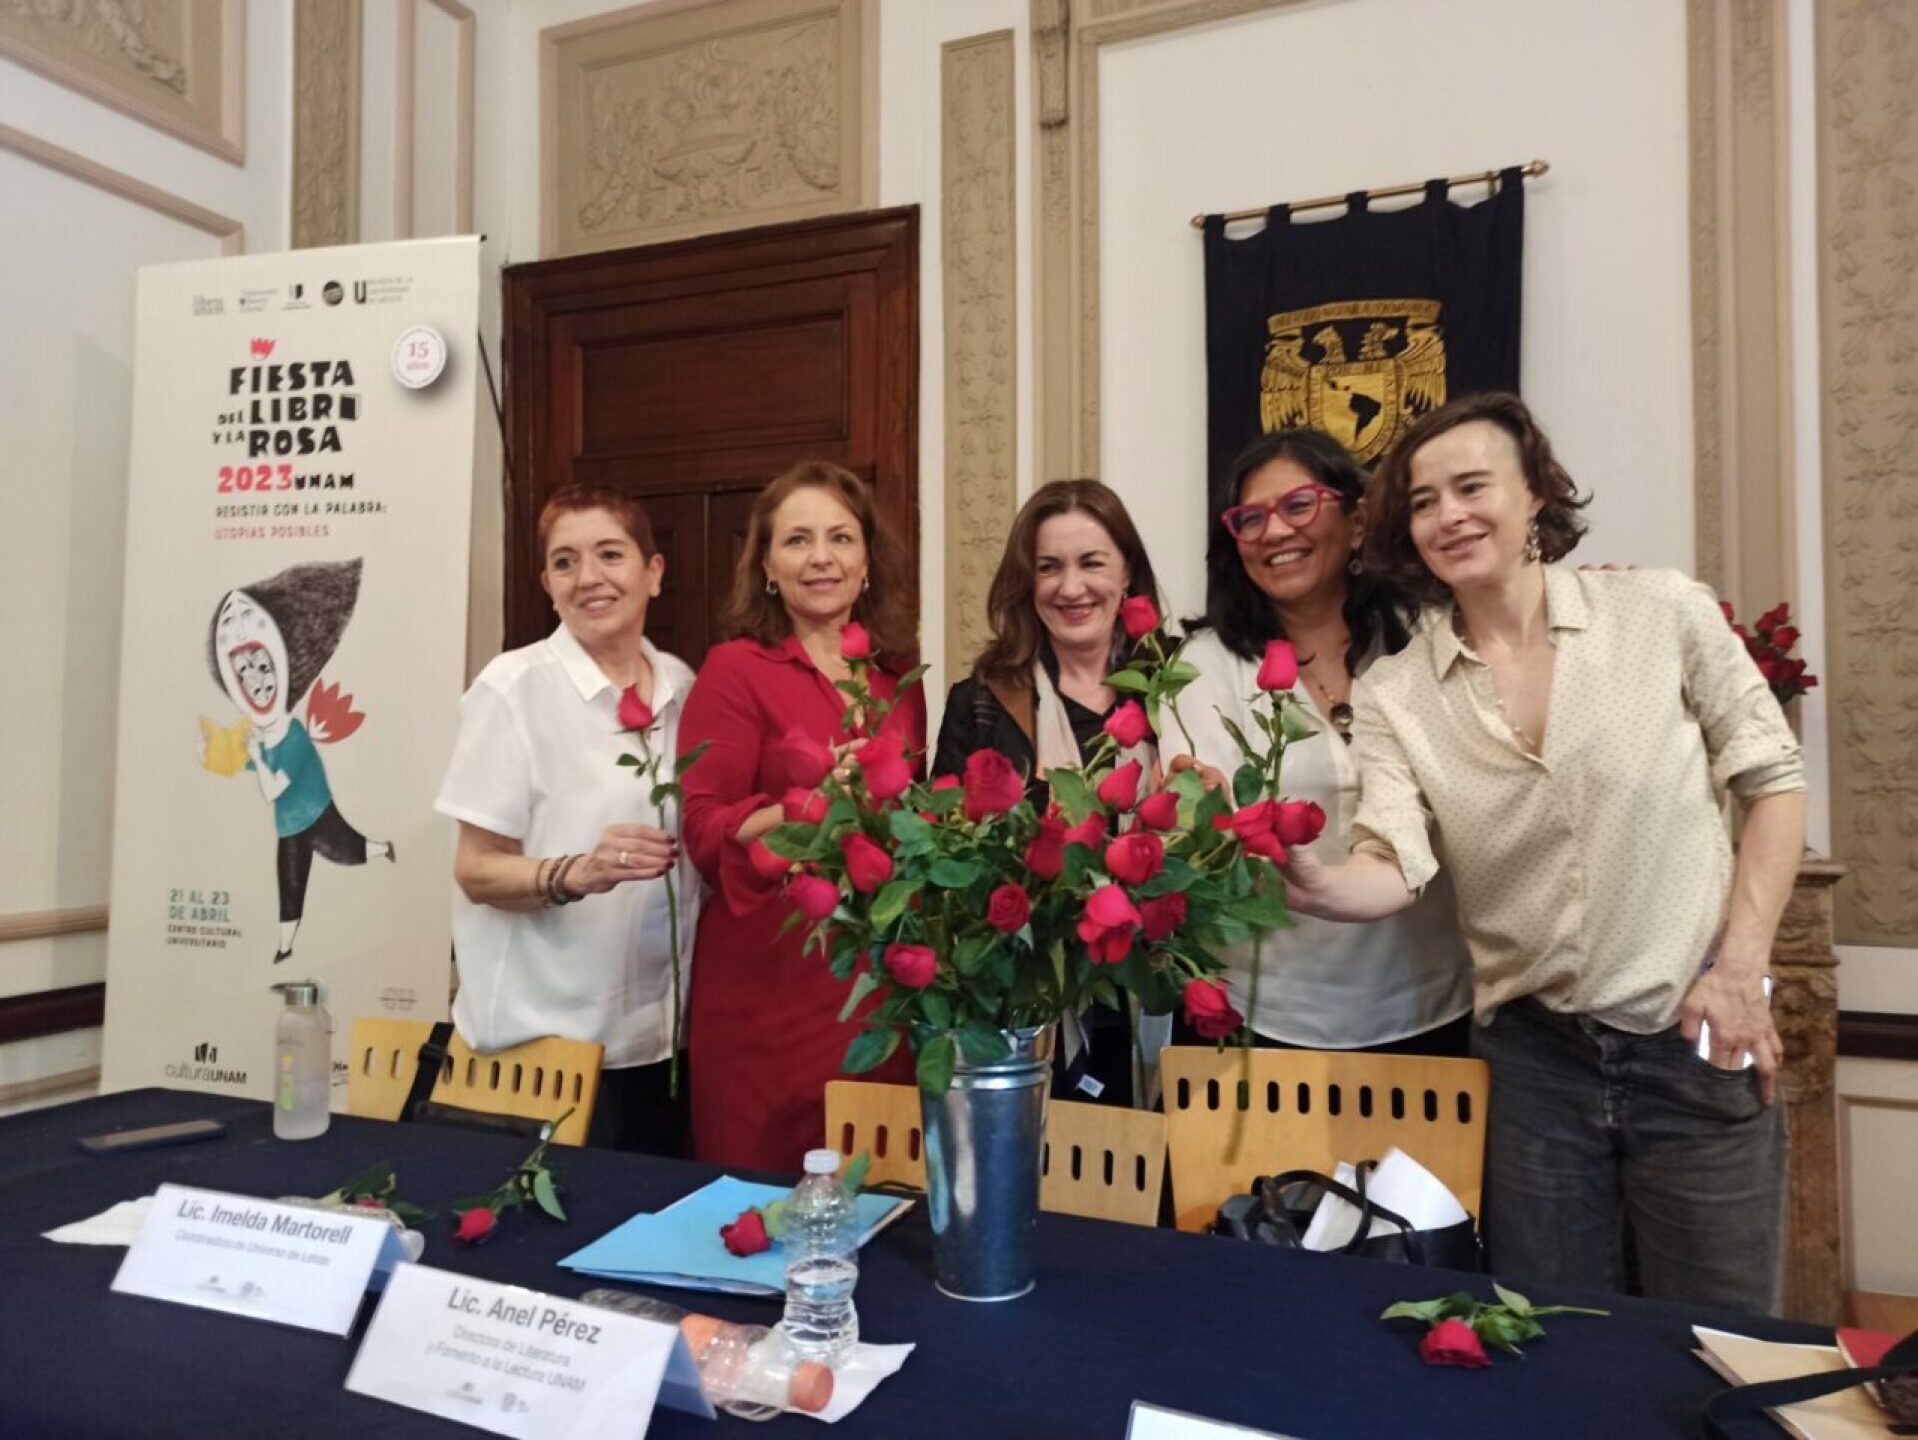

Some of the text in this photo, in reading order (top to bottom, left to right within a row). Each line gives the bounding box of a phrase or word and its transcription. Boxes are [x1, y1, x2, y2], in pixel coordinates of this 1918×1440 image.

[409, 341, 430, 358] 15
[228, 360, 355, 395] FIESTA
[225, 431, 245, 444] LA
[248, 425, 343, 458] ROSA
[217, 464, 355, 493] 2023 UNAM
[215, 504, 268, 518] RESISTIR
[273, 504, 299, 517] CON
[304, 503, 319, 516] LA
[270, 525, 330, 538] POSIBLES
[169, 888, 229, 906] 21 AL 23
[168, 905, 231, 923] DE ABRIL
[176, 1200, 353, 1245] Lic. Imelda Martorell
[447, 1286, 601, 1345] Lic. Anel Pérez
